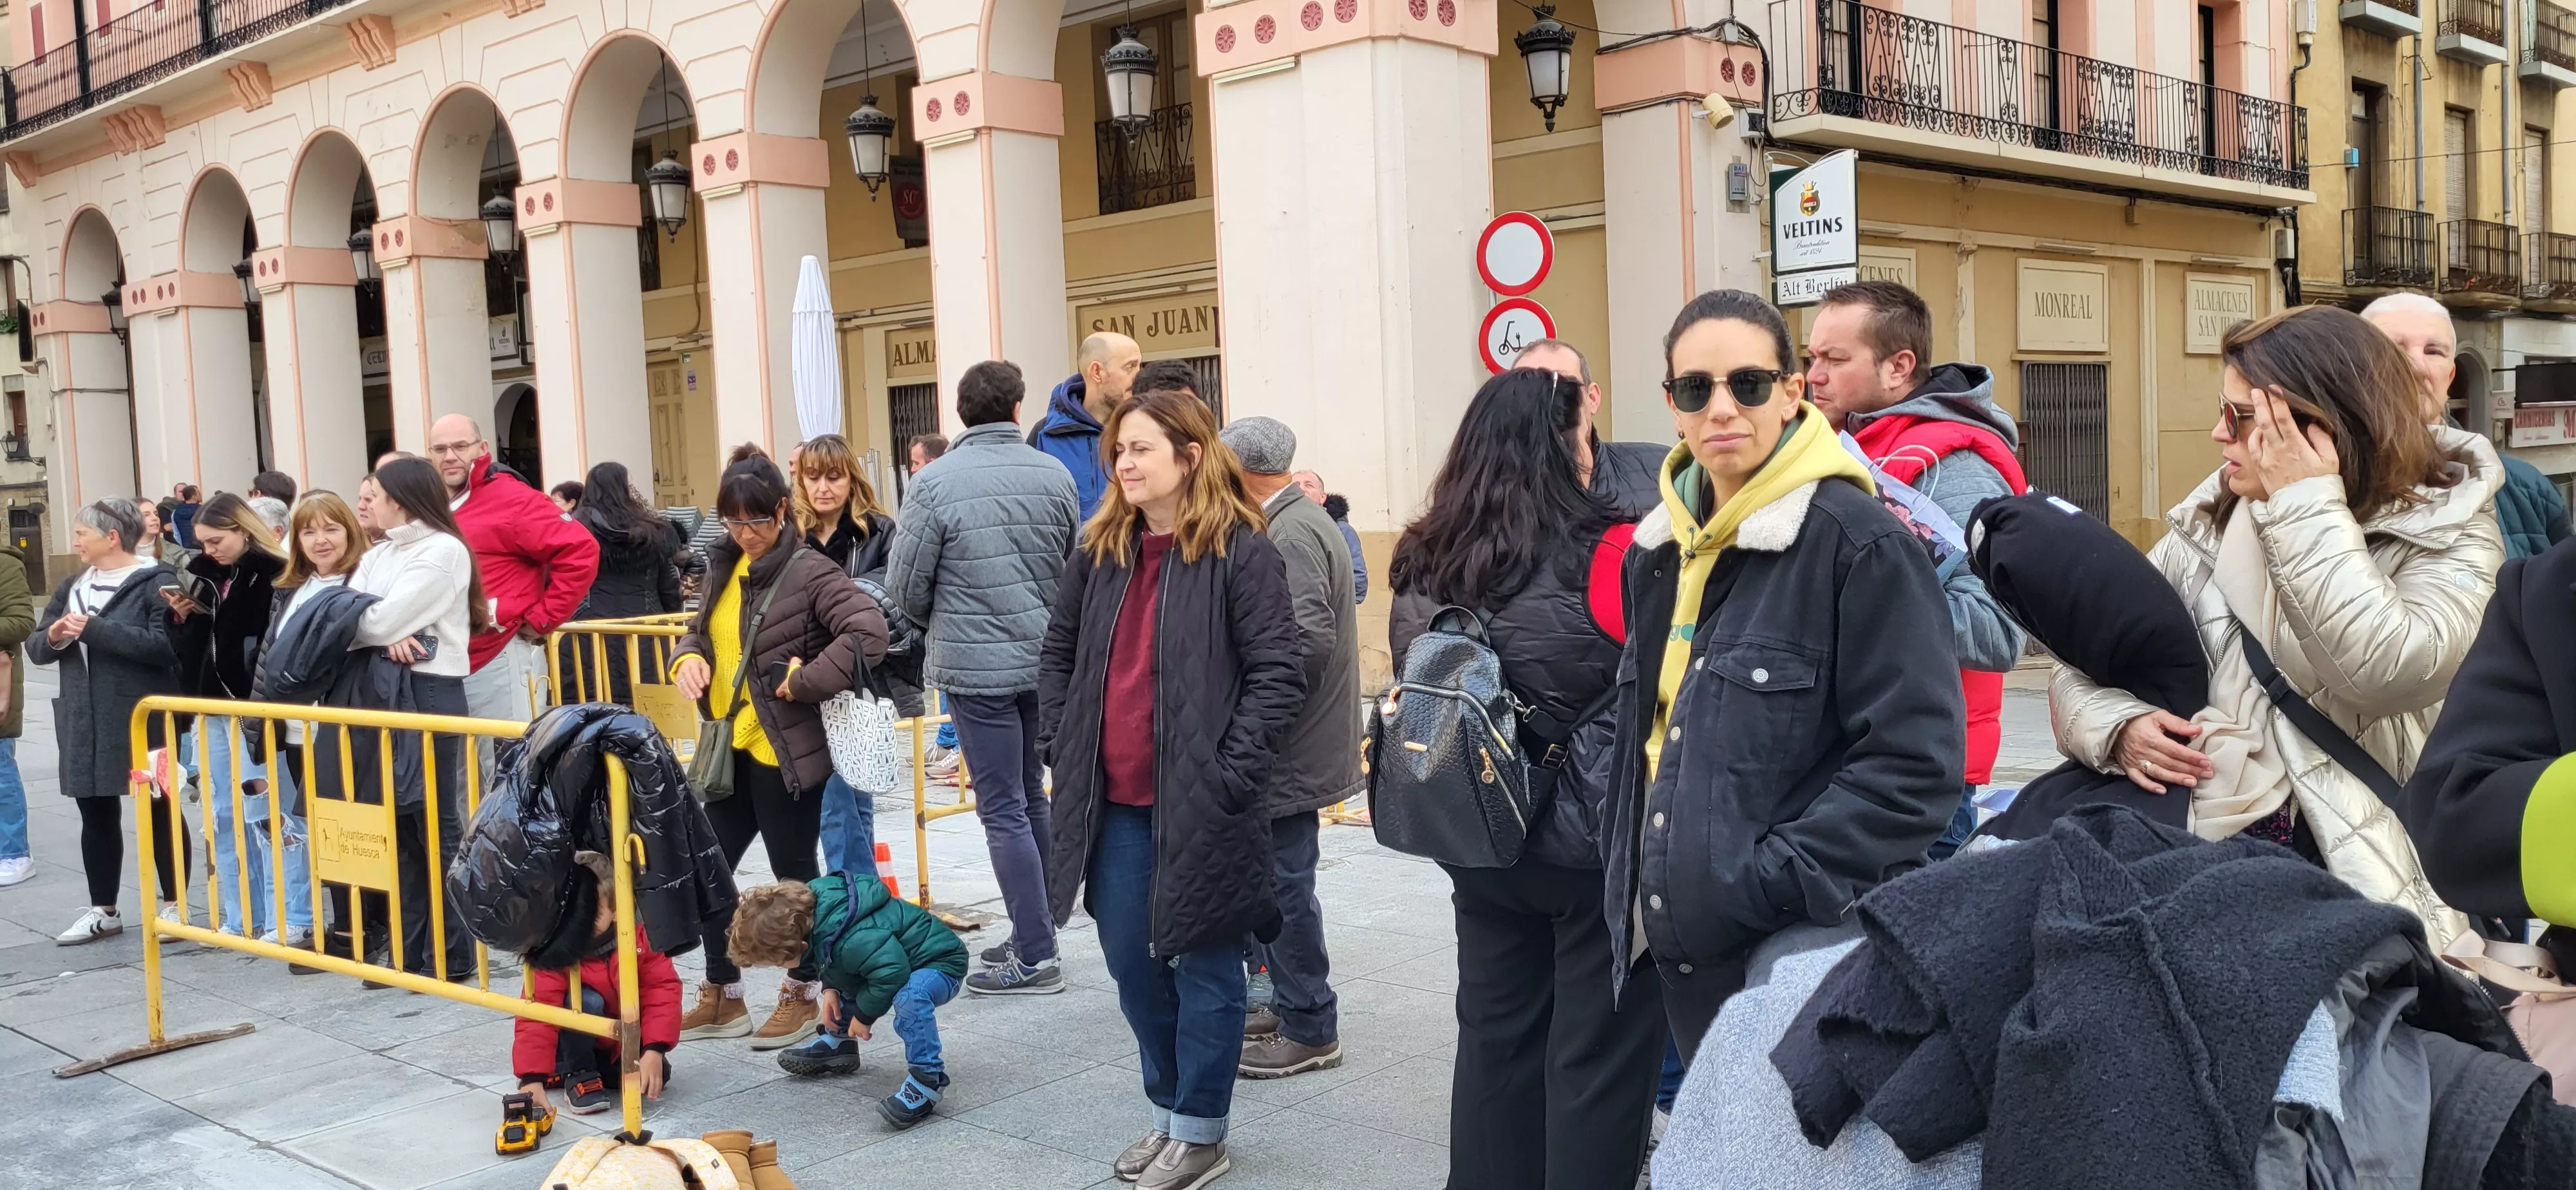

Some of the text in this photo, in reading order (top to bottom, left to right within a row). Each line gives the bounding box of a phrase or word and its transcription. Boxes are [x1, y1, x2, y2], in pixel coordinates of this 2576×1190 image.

[1783, 216, 1843, 240] VELTINS
[1809, 247, 1823, 256] 1824
[1782, 281, 1801, 298] Alt
[2193, 288, 2248, 313] ALMACENES
[2034, 291, 2093, 319] MONREAL
[1146, 305, 1209, 337] JUAN
[2198, 314, 2217, 337] SAN
[340, 843, 380, 859] de Huesca
